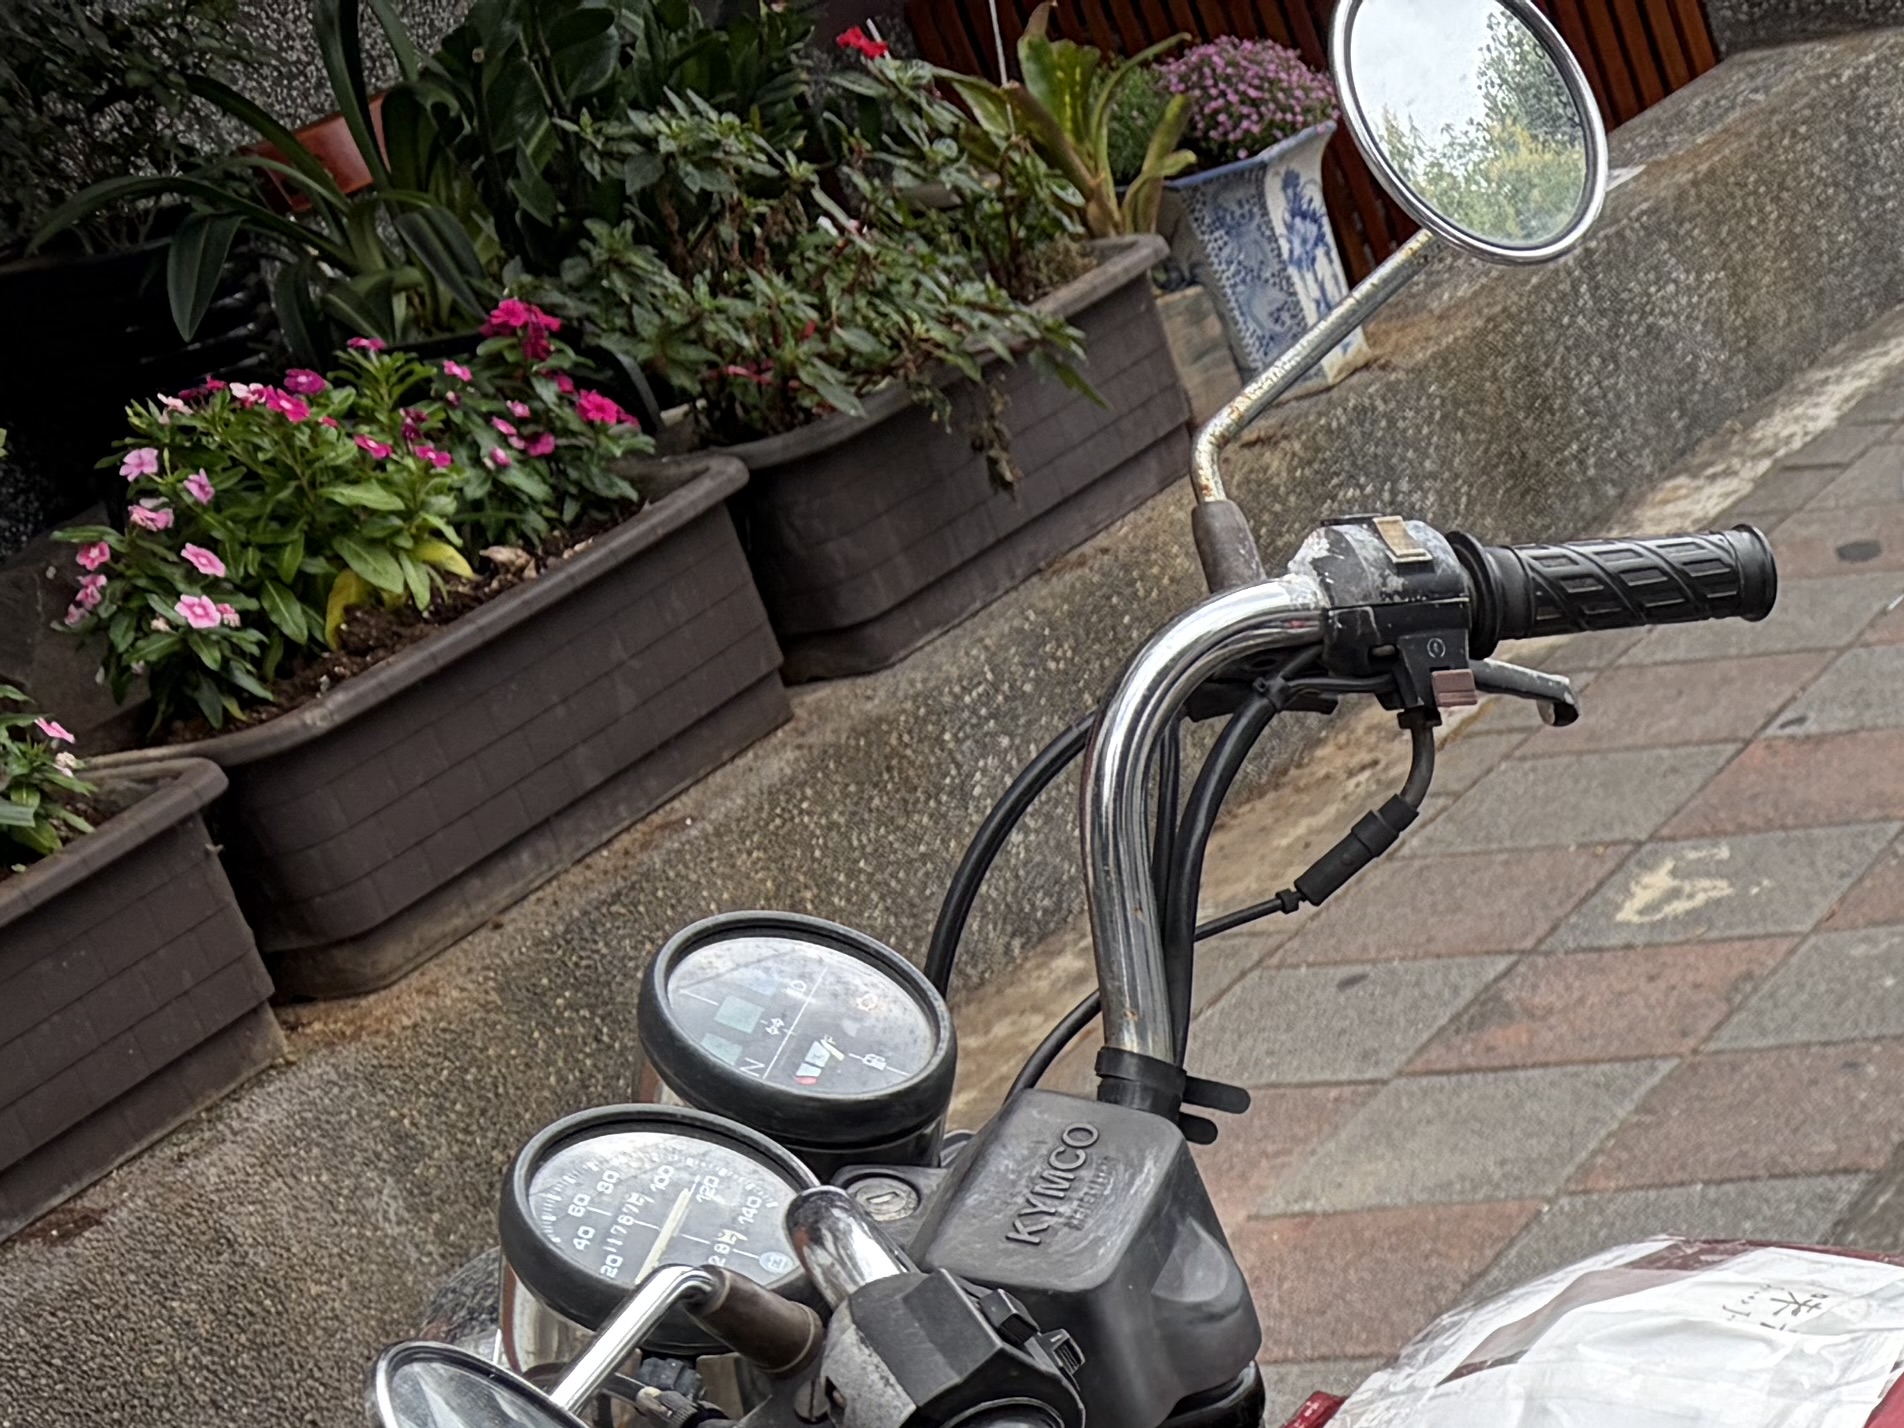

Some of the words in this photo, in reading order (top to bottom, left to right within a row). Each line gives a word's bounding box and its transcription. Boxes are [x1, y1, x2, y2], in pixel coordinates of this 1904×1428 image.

[1005, 1122, 1099, 1246] KYMCO
[567, 1193, 591, 1218] 60
[738, 1197, 762, 1226] 140
[572, 1225, 596, 1250] 40
[601, 1255, 623, 1279] 20
